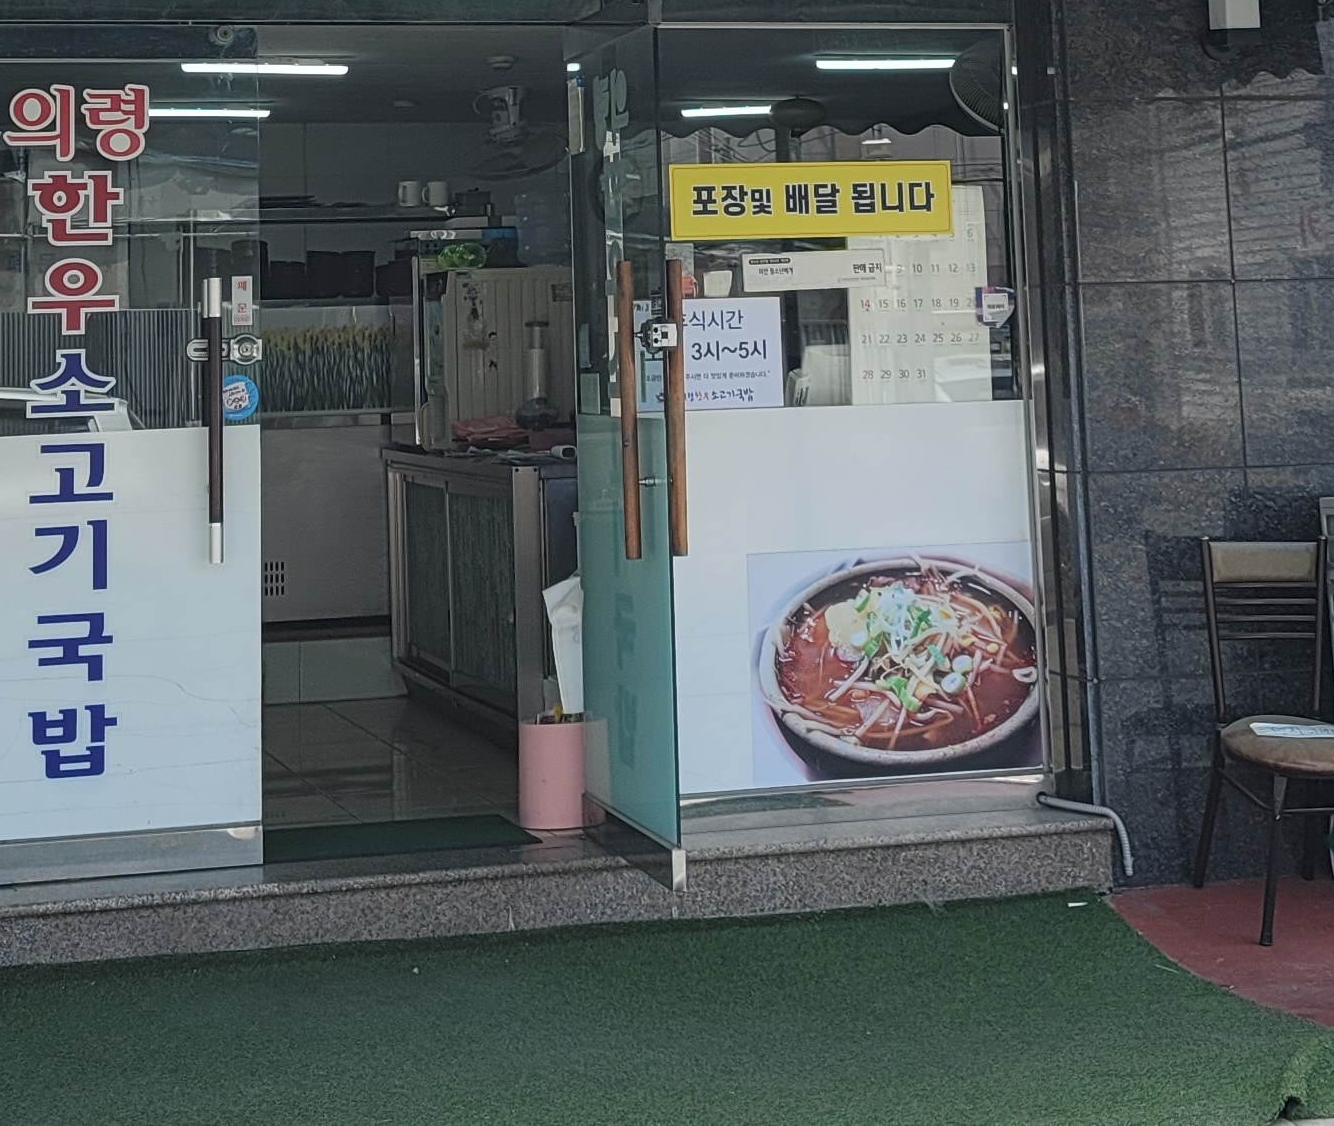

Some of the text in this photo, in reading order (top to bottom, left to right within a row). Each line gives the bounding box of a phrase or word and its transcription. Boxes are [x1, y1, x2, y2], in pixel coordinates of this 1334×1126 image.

[4, 85, 149, 161] 의령
[691, 180, 935, 217] 포장및 배달 됩니다
[868, 263, 882, 274] 금지
[912, 264, 923, 273] 10
[930, 263, 940, 272] 11
[948, 263, 958, 272] 12
[861, 299, 871, 308] 14
[878, 299, 889, 308] 15
[896, 299, 907, 308] 16
[913, 299, 924, 308] 17
[931, 299, 942, 308] 18
[949, 298, 959, 307] 19
[861, 333, 980, 344] 21 22 23 24 25 26 27
[691, 339, 767, 361] 3시~5시
[862, 369, 927, 379] 28 29 30 31
